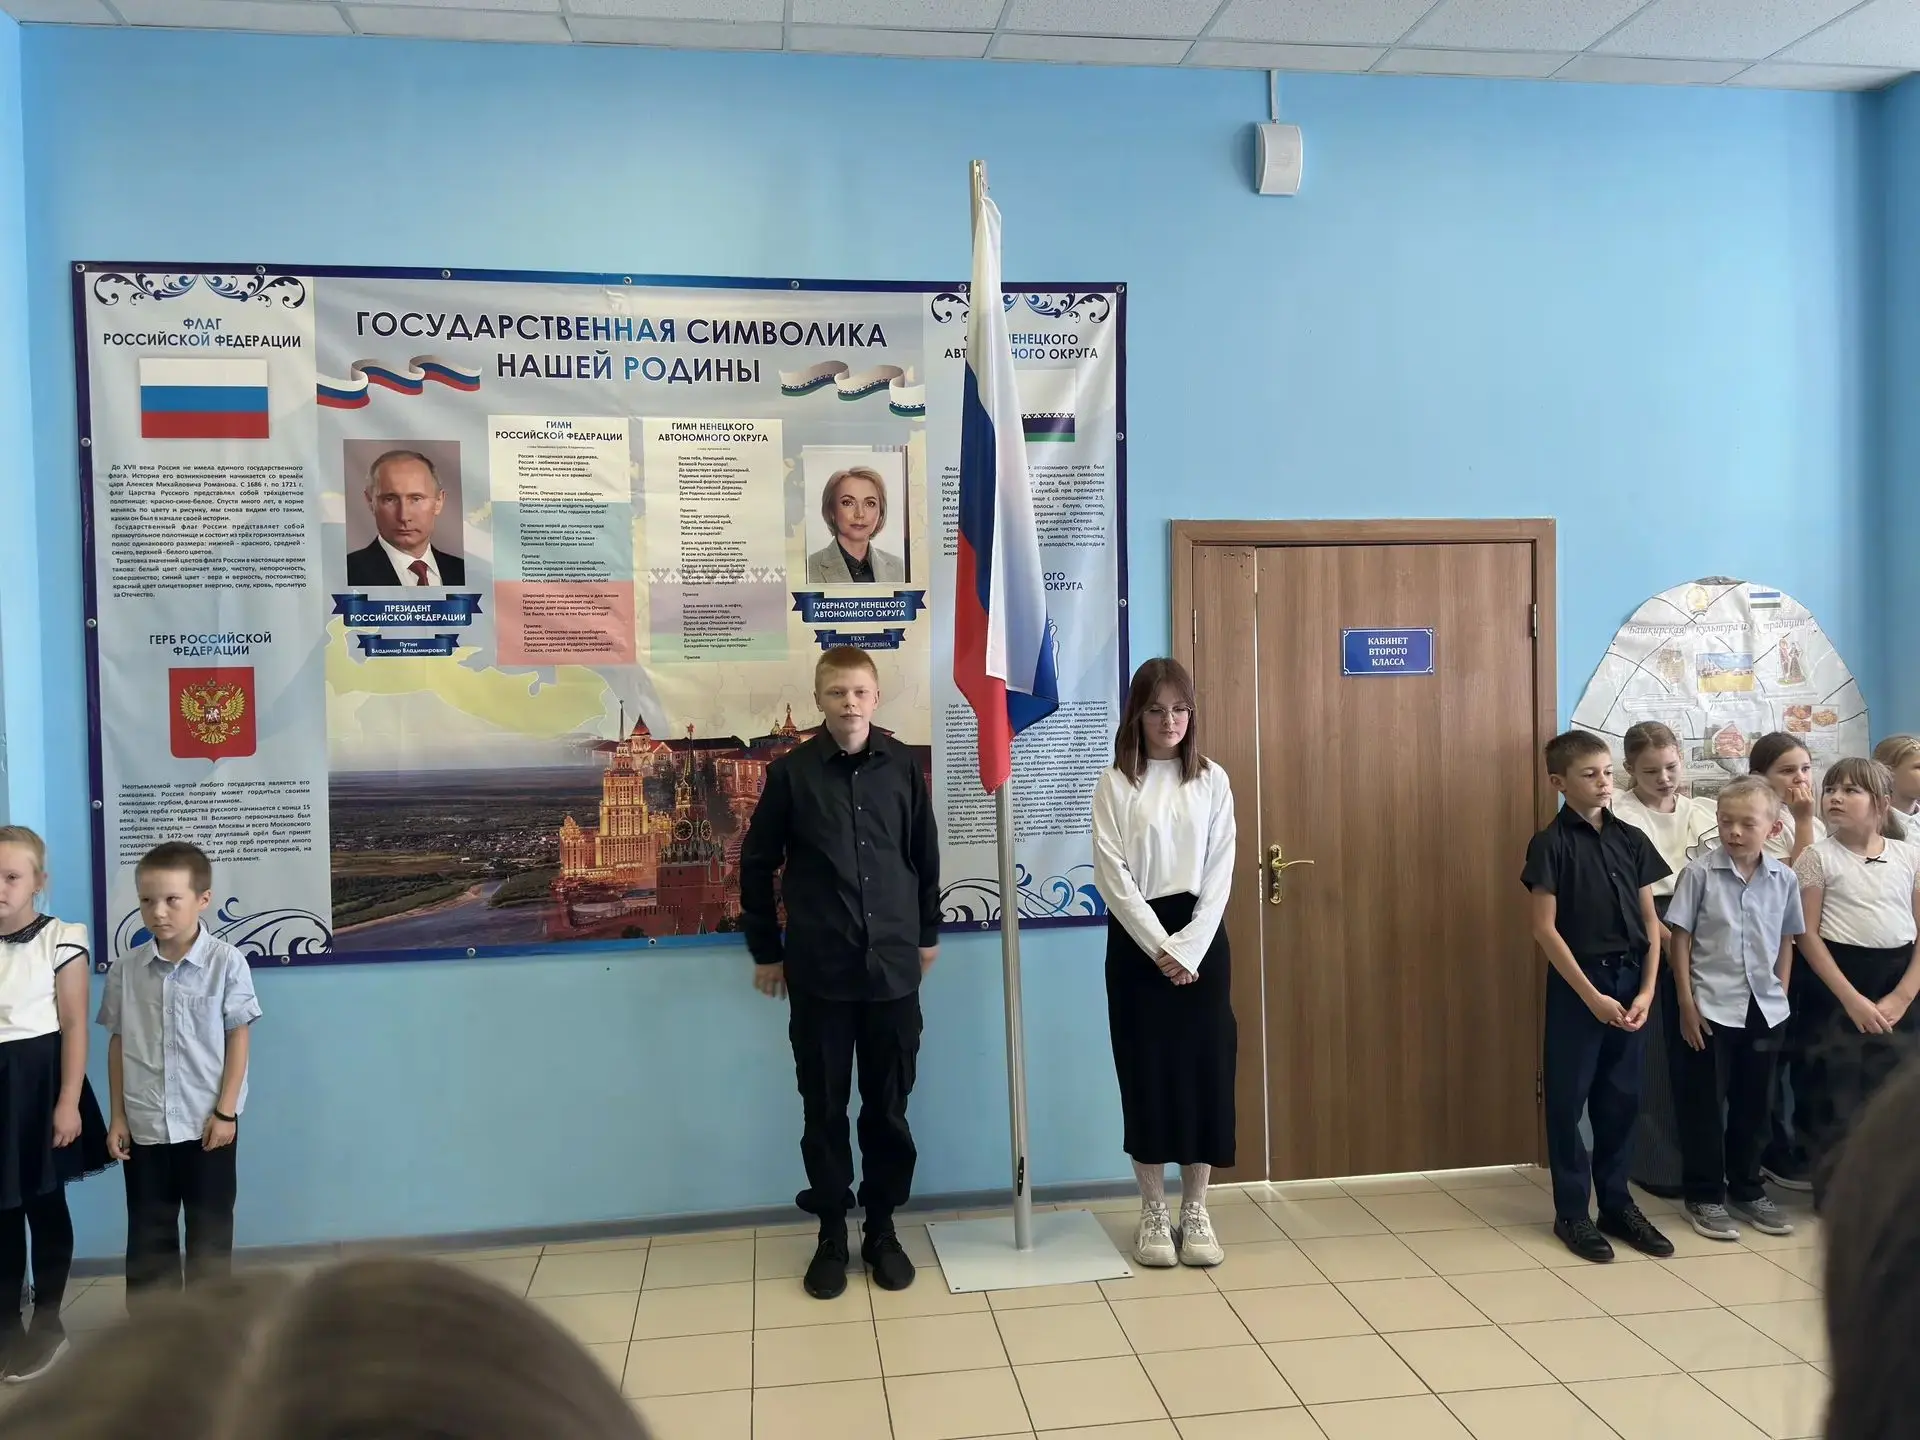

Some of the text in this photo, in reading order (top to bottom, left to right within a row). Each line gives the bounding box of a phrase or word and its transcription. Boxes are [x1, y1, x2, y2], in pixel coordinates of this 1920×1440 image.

[183, 318, 222, 329] ФЛАГ
[355, 310, 888, 348] ГОСУДАРСТВЕННАЯ СИМВОЛИКА
[103, 331, 301, 349] РОССИЙСКОЙ ФЕДЕРАЦИИ
[1049, 348, 1098, 359] ОКРУГА
[496, 349, 761, 387] НАШЕЙ РОДИНЫ
[546, 421, 572, 429] ГИМН
[672, 423, 754, 432] ГИМН НЕНЕЦКОГО
[496, 430, 623, 441] РОССИЙСКОЙ ФЕДЕРАЦИИ
[658, 434, 768, 442] АВТОНОМНОГО ОКРУГА
[1045, 582, 1083, 590] ОКРУГА
[384, 605, 431, 613] ПРЕЗИДЕНТ
[861, 601, 906, 609] НЕНЕЦКОГО
[350, 612, 466, 622] РОССИЙСКОЙ ФЕДЕРАЦИИ
[814, 610, 874, 618] АВТОНОМНОГО
[1695, 624, 1738, 637] культура
[149, 631, 272, 644] ГЕРБ РОССИЙСКОЙ
[1368, 637, 1408, 645] КАБИНЕТ
[172, 646, 250, 657] ФЕДЕРАЦИИ
[1372, 658, 1405, 666] КЛАССА
